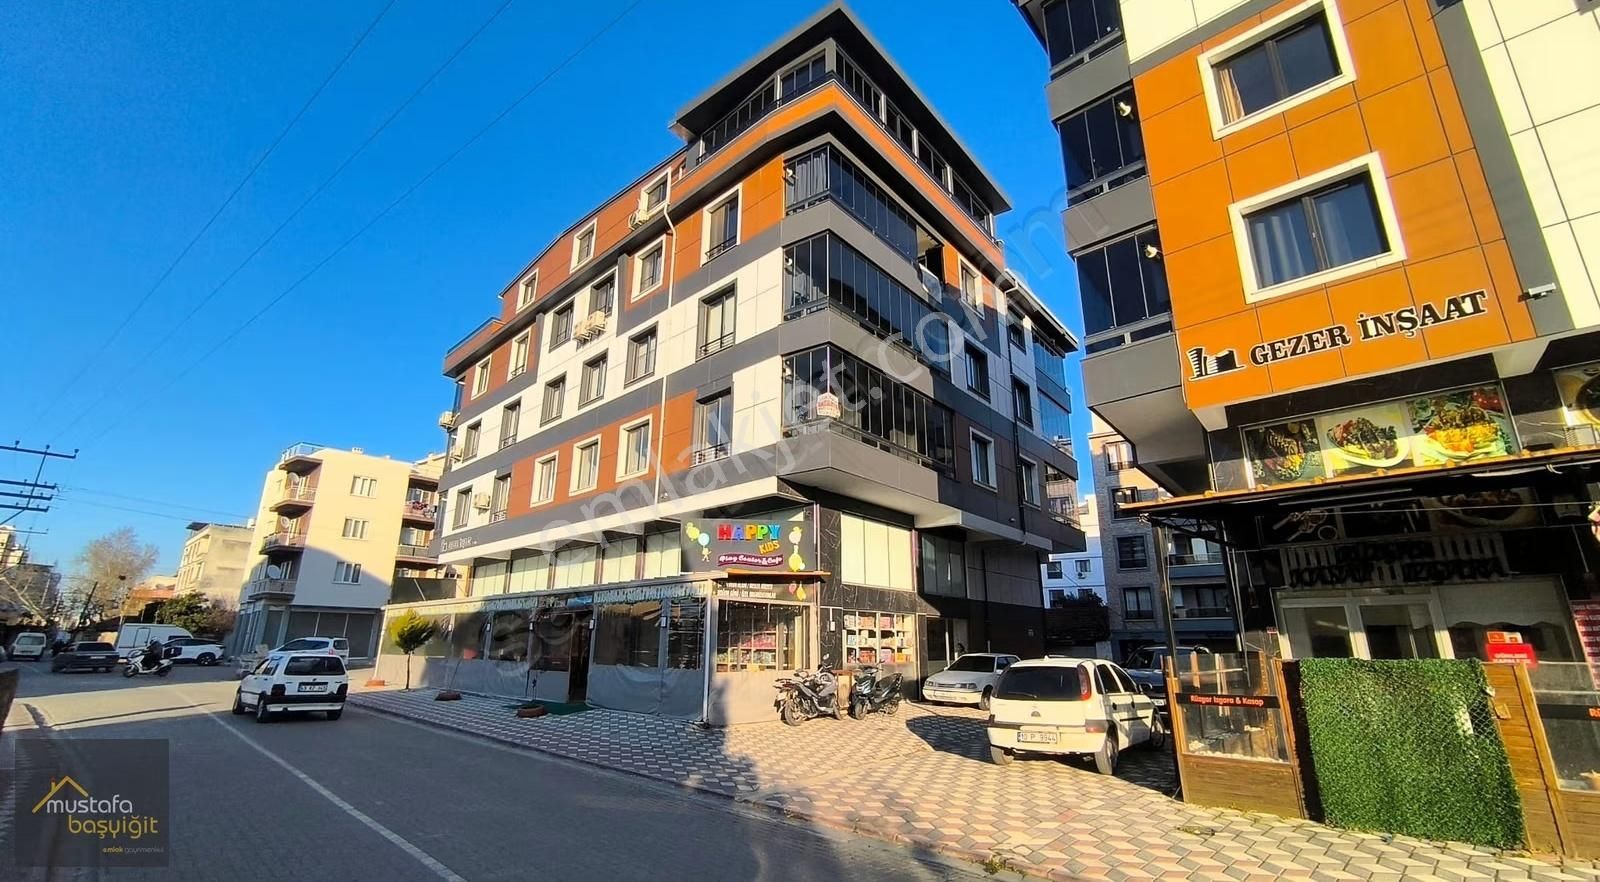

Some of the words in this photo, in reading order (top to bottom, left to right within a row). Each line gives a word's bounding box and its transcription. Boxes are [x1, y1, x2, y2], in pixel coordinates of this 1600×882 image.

[1250, 325, 1350, 366] GEZER
[1358, 290, 1487, 339] İNŞAAT
[717, 523, 781, 542] HAPPY
[758, 541, 781, 555] KIDS
